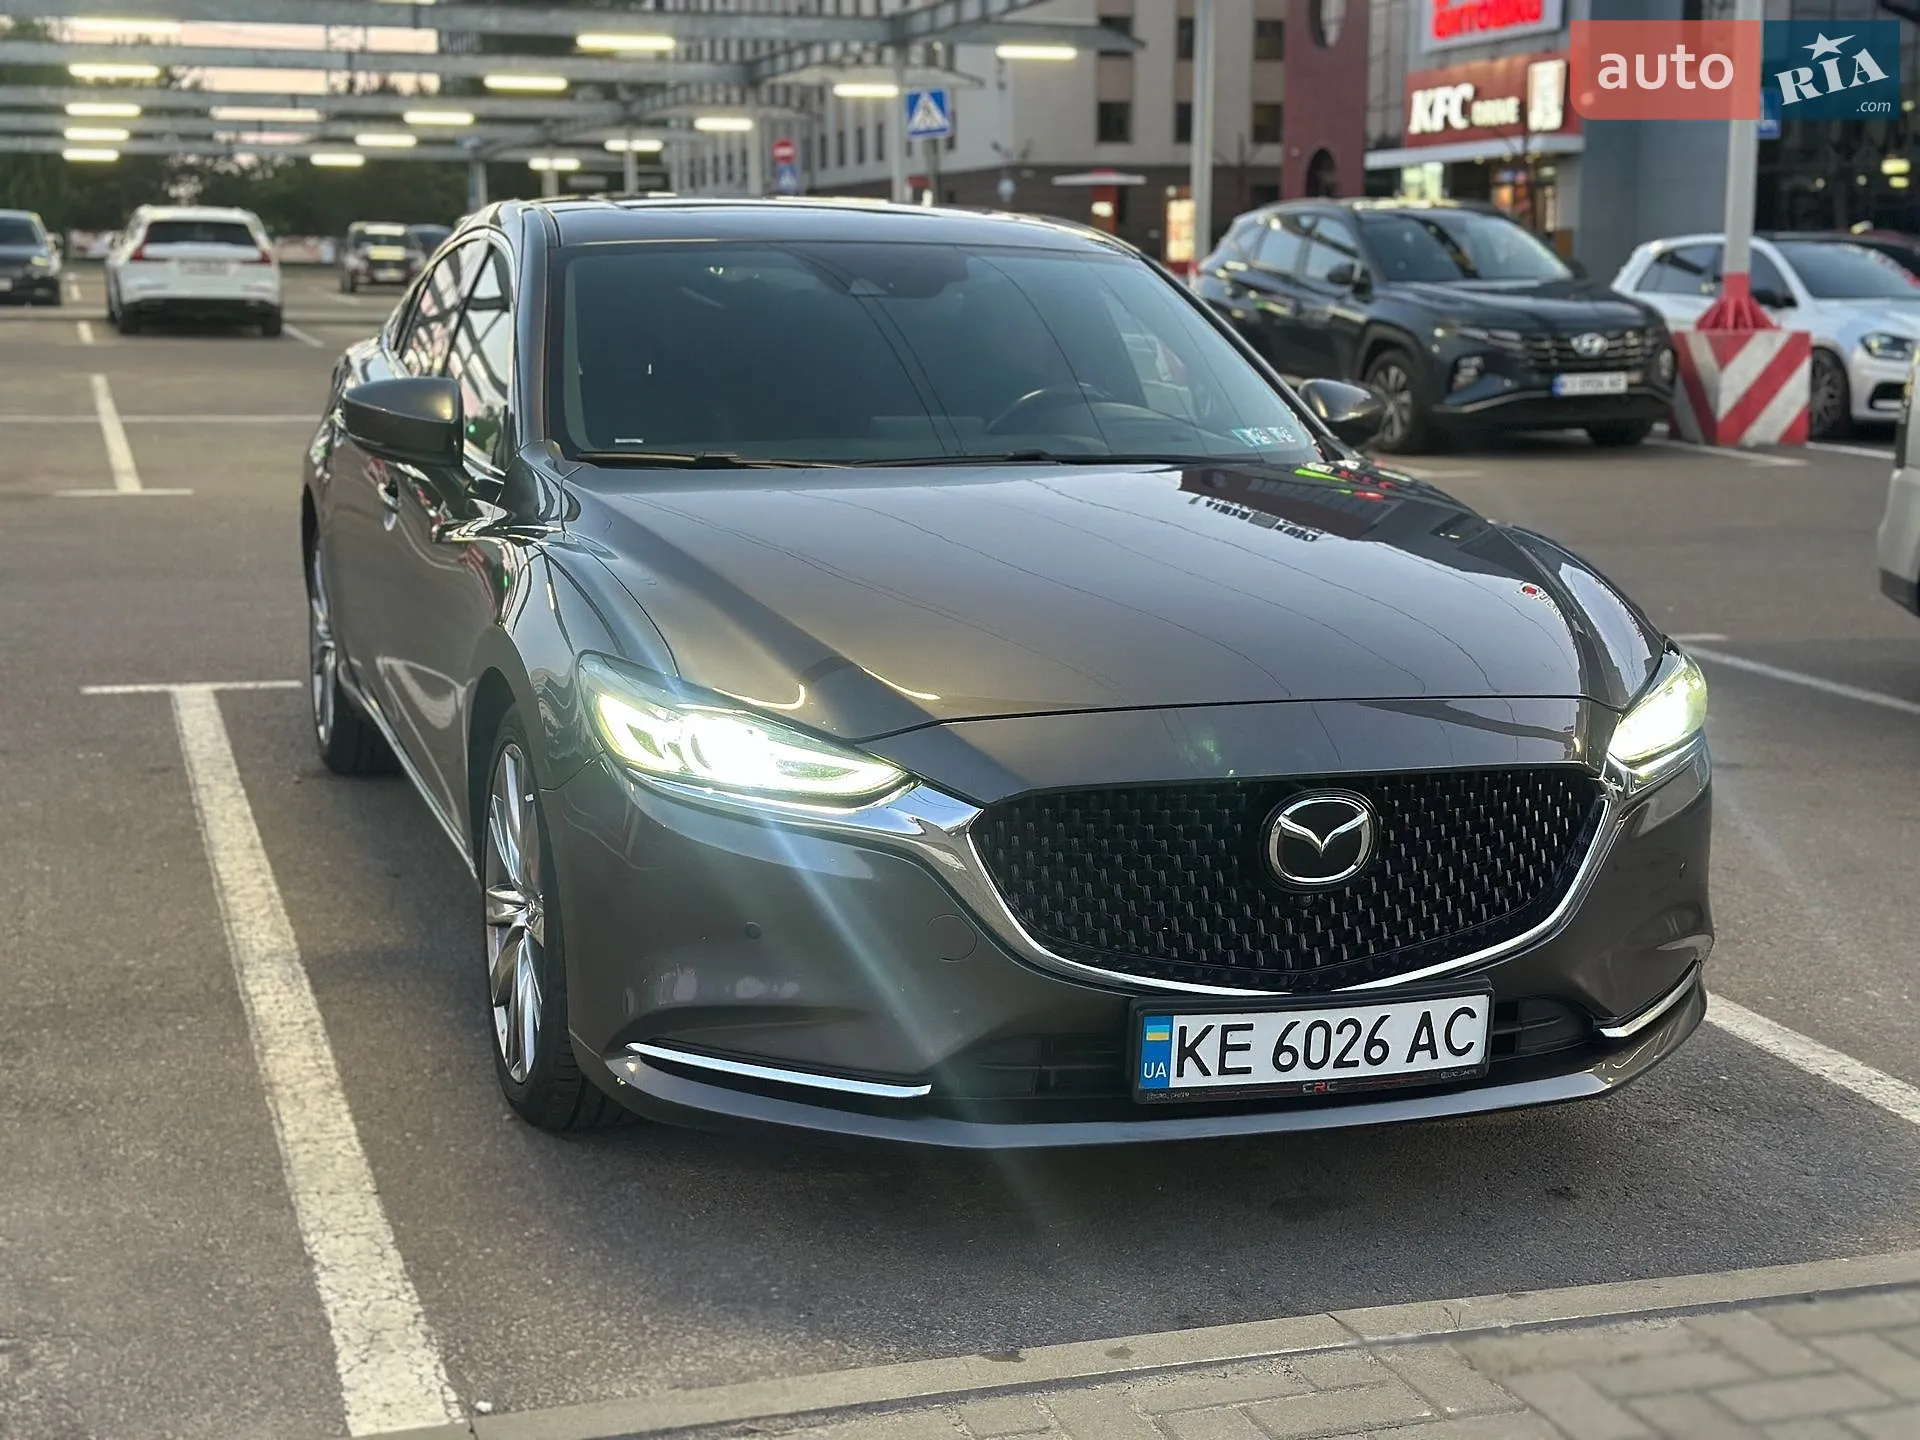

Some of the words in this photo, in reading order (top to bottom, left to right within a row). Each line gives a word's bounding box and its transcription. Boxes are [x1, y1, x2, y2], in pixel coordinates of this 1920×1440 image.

[1408, 83, 1475, 134] KFC
[1175, 1022, 1254, 1078] KE
[1271, 1014, 1391, 1073] 6026
[1405, 1006, 1477, 1064] AC
[1143, 1062, 1168, 1079] UA
